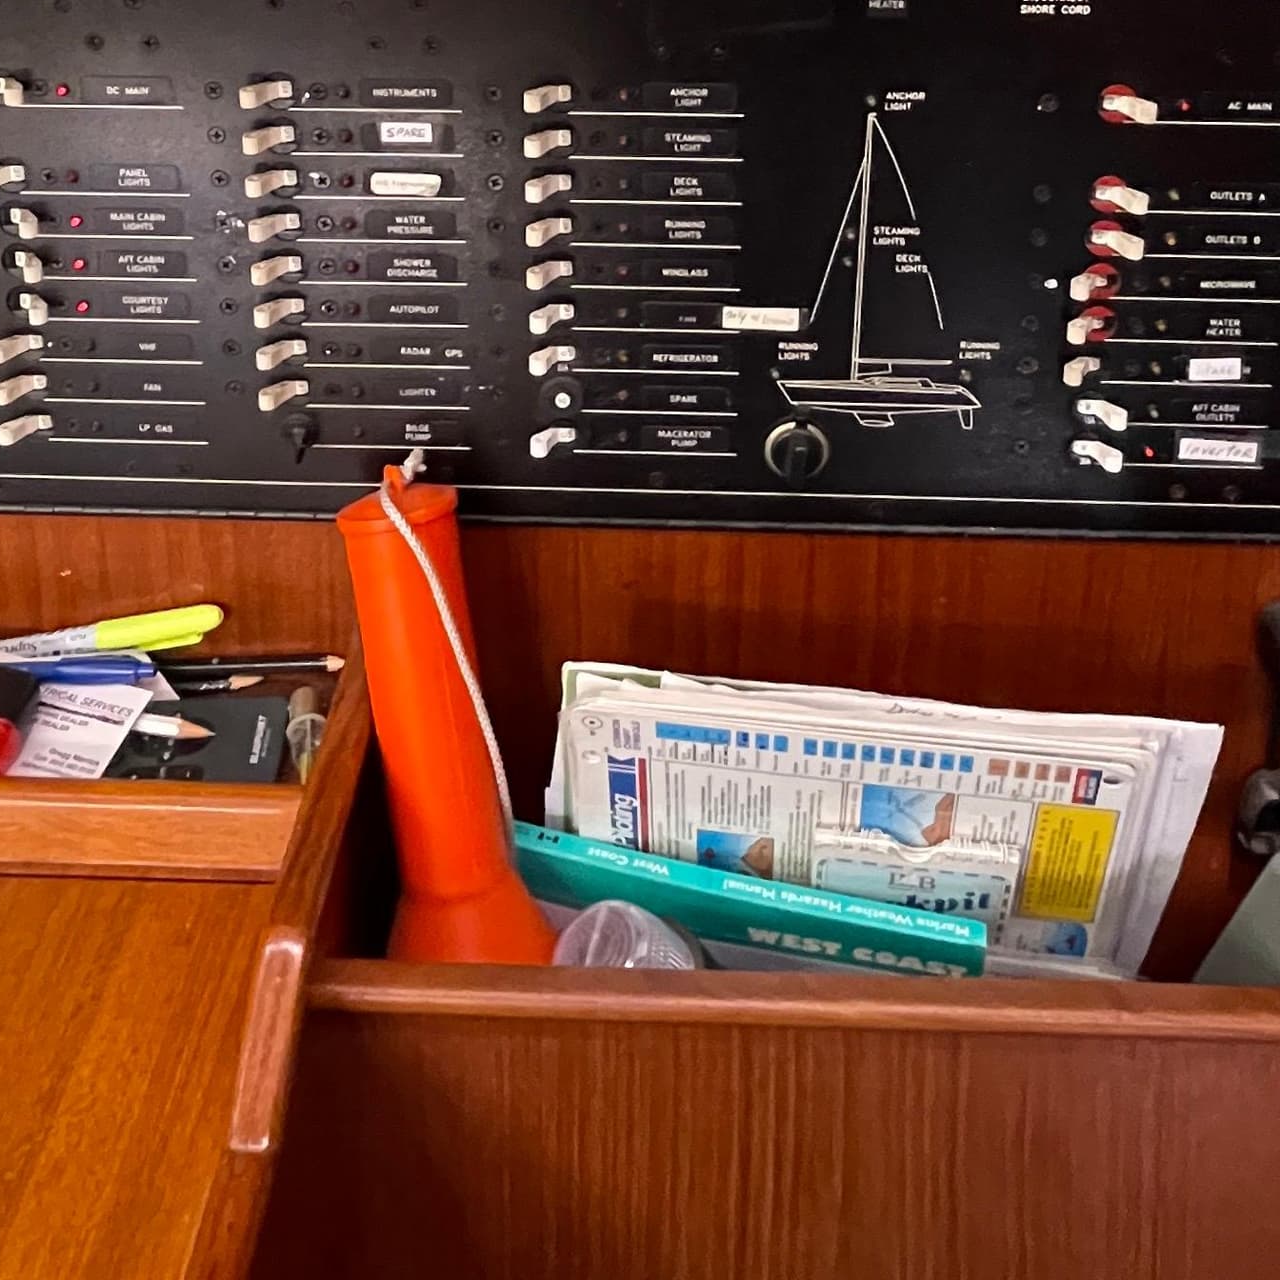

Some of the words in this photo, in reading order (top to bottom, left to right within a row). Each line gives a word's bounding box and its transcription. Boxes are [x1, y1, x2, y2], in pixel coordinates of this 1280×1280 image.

[868, 0, 905, 10] HEATER
[1020, 4, 1056, 15] SHORE
[1061, 4, 1091, 16] CORD
[106, 86, 120, 95] DC
[125, 86, 151, 95] MAIN
[372, 87, 438, 98] INSTRUMENTS
[670, 88, 708, 97] ANCHOR
[886, 92, 926, 100] ANCHOR
[675, 97, 702, 106] LIGHT
[1227, 101, 1242, 111] AC
[1247, 102, 1273, 111] MAIN
[884, 102, 912, 111] LIGHT
[386, 127, 427, 138] SPARE
[664, 133, 712, 143] STEAMING
[674, 143, 702, 152] LIGHT
[119, 169, 148, 178] PANEL
[118, 178, 151, 187] LIGHTS
[673, 177, 698, 186] DECK
[670, 187, 703, 196] LIGHTS
[1210, 191, 1253, 201] OUTLETS
[1258, 193, 1266, 202] A
[110, 213, 134, 222] MAIN
[137, 213, 166, 222] CABIN
[395, 215, 426, 224] WATER
[122, 222, 155, 231] LIGHTS
[664, 220, 706, 229] RUNNING
[387, 225, 434, 235] PRESSURE
[669, 230, 702, 239] LIGHTS
[873, 226, 921, 236] STEAMING
[872, 236, 906, 246] LIGHTS
[1205, 235, 1248, 245] OUTLETS
[118, 255, 134, 264] AFT
[137, 255, 165, 265] CABIN
[393, 259, 432, 267] SHOWER
[895, 254, 921, 263] DECK
[127, 264, 159, 273] LIGHTS
[387, 268, 438, 278] DISCHARGE
[895, 264, 929, 273] LIGHTS
[1200, 281, 1256, 289] MICROWAVE
[122, 296, 168, 305] COURTESY
[130, 305, 162, 314] LIGHTS
[389, 305, 440, 314] AUTOPILOT
[1209, 319, 1241, 328] WATER
[1206, 327, 1242, 337] HEATER
[138, 342, 157, 351] VHF
[777, 342, 819, 351] RUNNING
[959, 341, 1001, 350] RUNNING
[400, 346, 431, 355] RADAR
[445, 349, 463, 358] GPS
[778, 351, 810, 361] LIGHTS
[959, 351, 992, 360] LIGHTS
[652, 353, 719, 363] REFRIGERATOR
[143, 383, 162, 392] FAN
[399, 388, 436, 396] LIGHTER
[670, 394, 698, 403] SPARE
[1192, 404, 1208, 412] AFT
[1210, 404, 1241, 412] CABIN
[1195, 413, 1236, 422] OUTLETS
[138, 424, 151, 432] LP
[155, 424, 173, 433] GAS
[405, 424, 430, 433] BILGE
[405, 432, 432, 441] PUMP
[657, 430, 712, 439] MACERATOR
[671, 439, 698, 447] PUMP
[587, 846, 629, 867] Coast
[632, 858, 670, 877] West
[722, 877, 777, 902] Manual
[779, 890, 843, 914] Hazards
[845, 903, 913, 929] Weather
[916, 916, 971, 938] Marine
[745, 926, 845, 957] WEST
[852, 945, 969, 979] COAST
